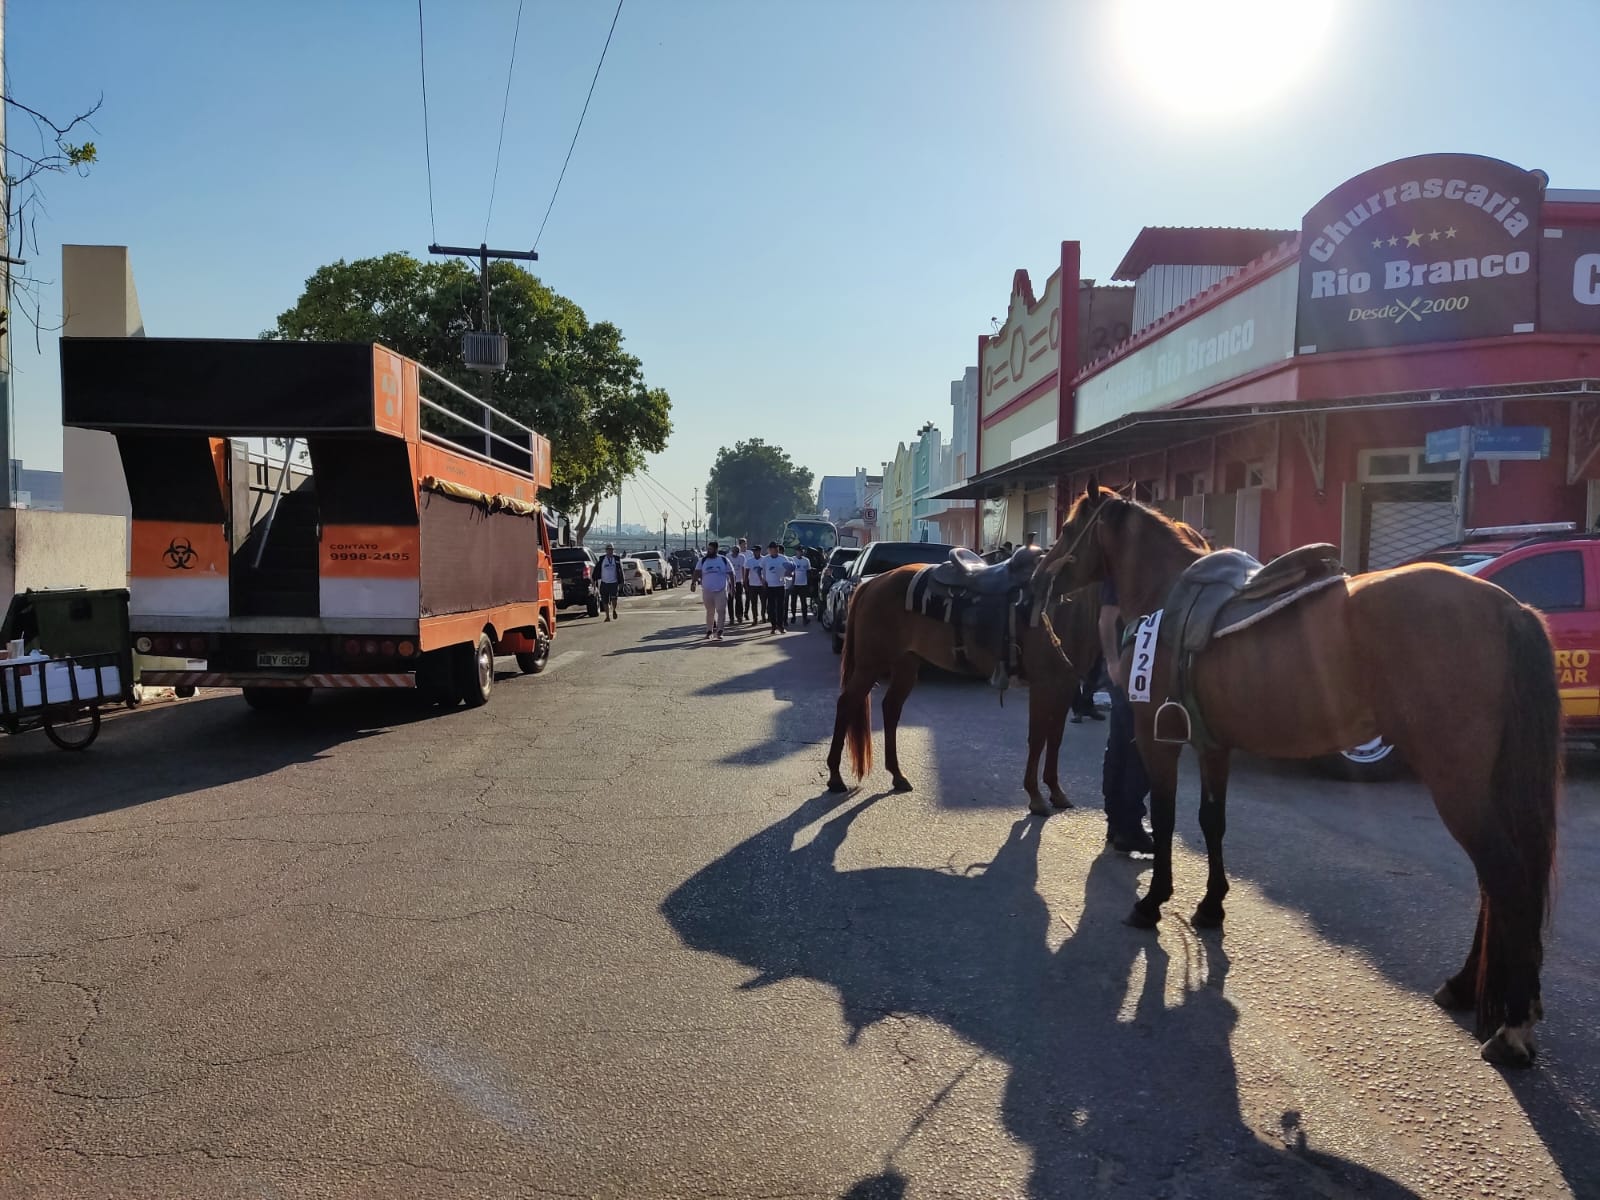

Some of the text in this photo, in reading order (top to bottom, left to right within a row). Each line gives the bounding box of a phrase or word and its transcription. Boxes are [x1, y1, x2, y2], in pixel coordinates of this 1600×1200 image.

[1309, 178, 1529, 262] Churrascaria
[1311, 251, 1530, 298] Rio Branco
[1348, 296, 1469, 322] Desde 2000
[1157, 319, 1255, 386] Rio Branco
[330, 552, 410, 561] 9998-2495
